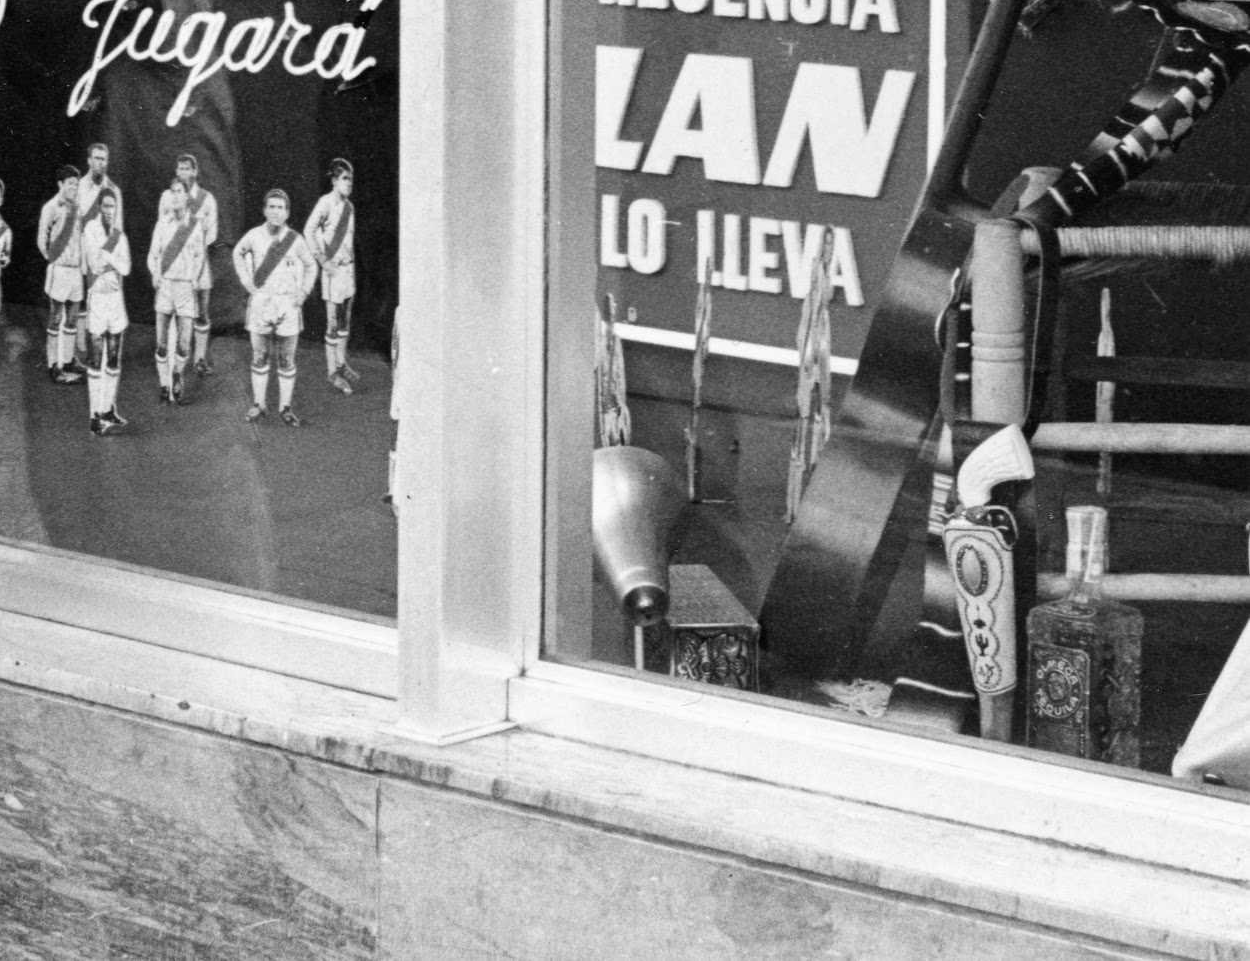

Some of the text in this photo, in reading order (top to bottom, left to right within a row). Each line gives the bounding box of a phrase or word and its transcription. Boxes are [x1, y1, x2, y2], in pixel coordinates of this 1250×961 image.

[595, 45, 917, 199] LAN
[601, 193, 866, 307] LO LLEVA
[1036, 659, 1079, 686] OLMECA
[1036, 688, 1079, 716] TEQUILA
